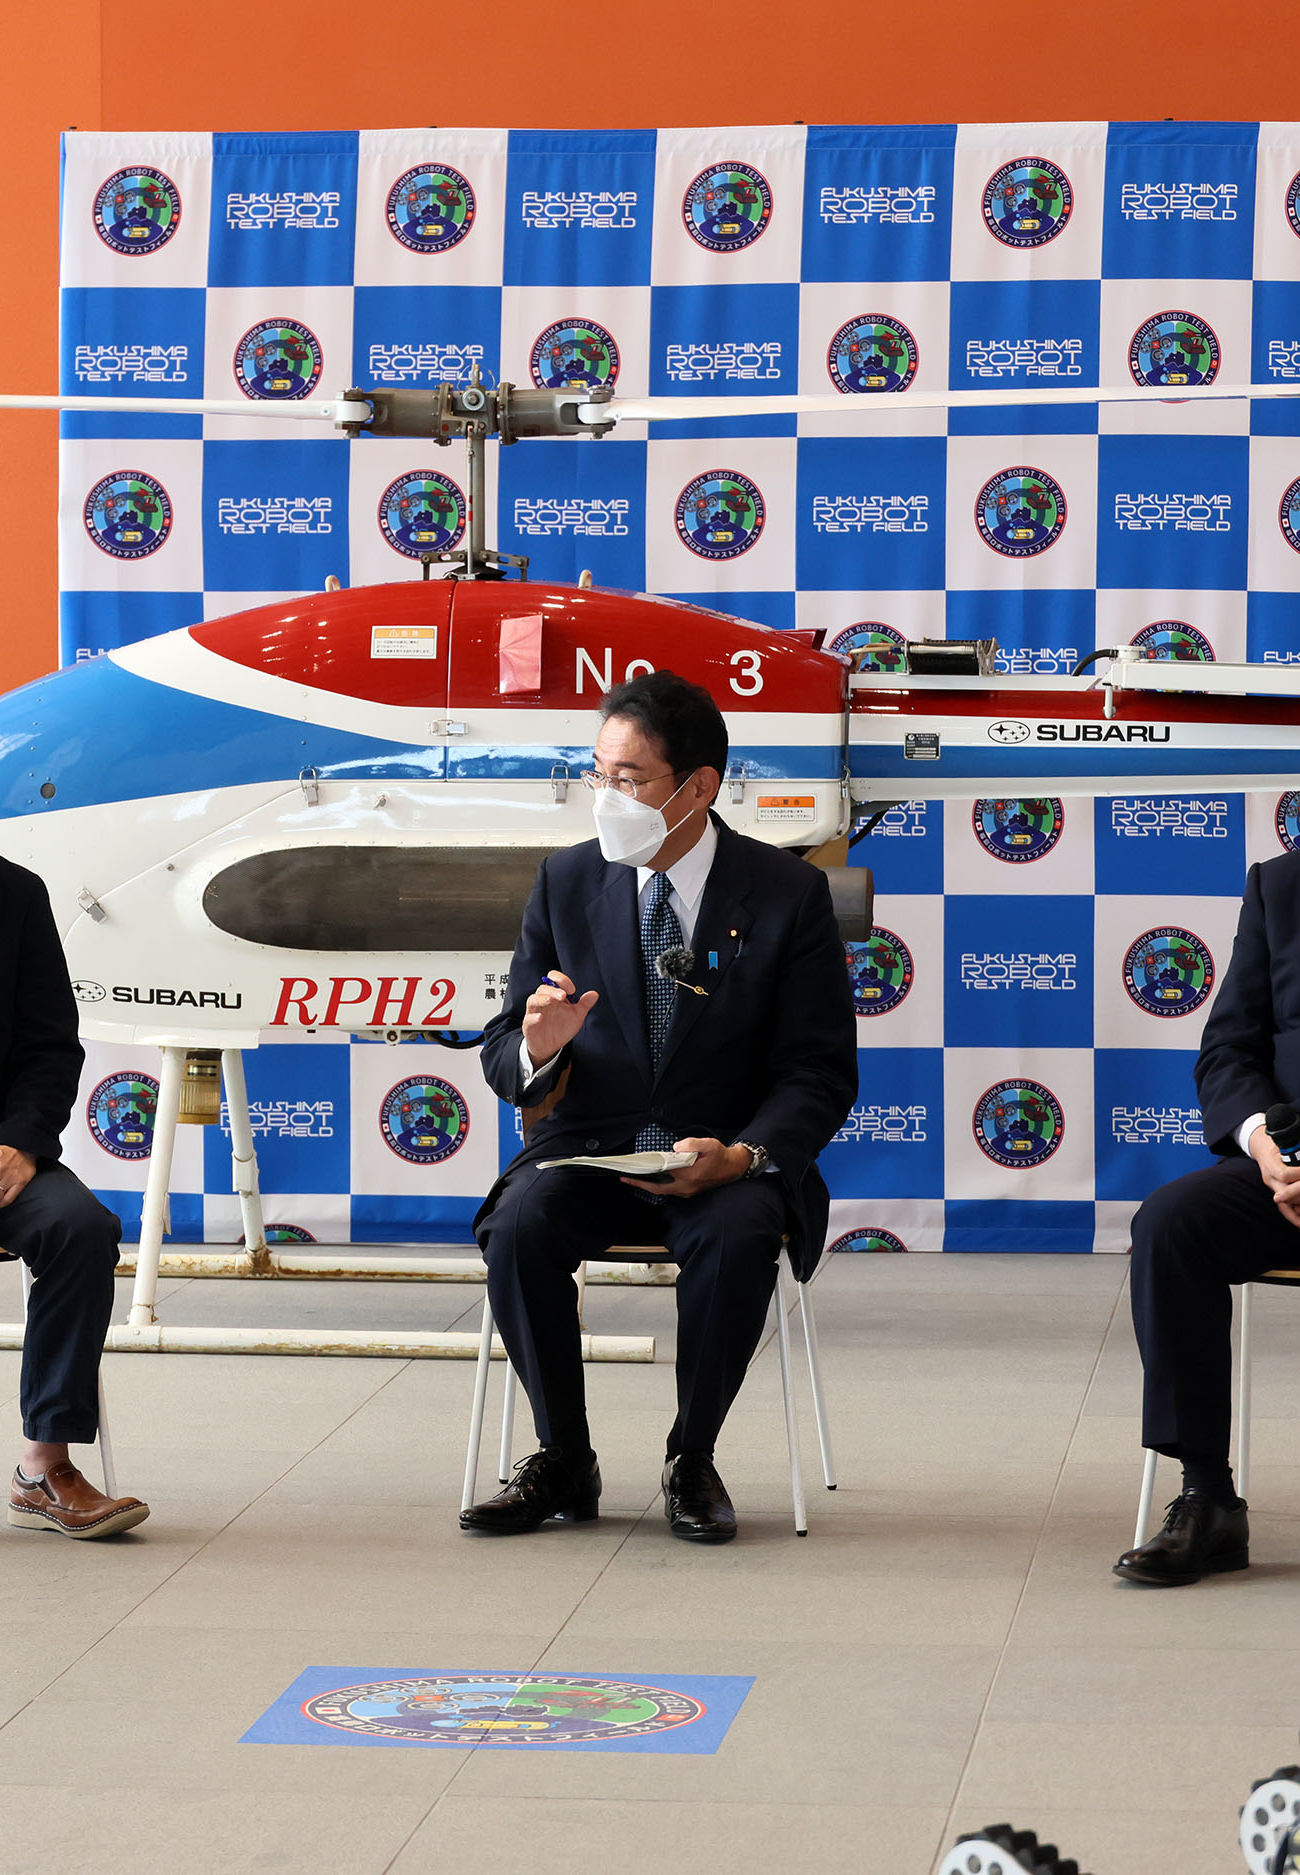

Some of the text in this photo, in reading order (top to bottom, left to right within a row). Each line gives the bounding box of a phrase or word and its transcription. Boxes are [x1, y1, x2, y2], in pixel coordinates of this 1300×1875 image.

[125, 168, 151, 176] ROBOT
[154, 173, 171, 188] TEST
[419, 166, 445, 174] ROBOT
[448, 171, 464, 186] TEST
[745, 169, 761, 184] TEST
[1045, 164, 1062, 179] TEST
[820, 187, 935, 197] FUKUSHIMA
[1121, 184, 1238, 194] FUKUSHIMA
[227, 192, 340, 203] FUKUSHIMA
[522, 192, 637, 202] FUKUSHIMA
[1121, 195, 1238, 209] ROBOT
[227, 203, 340, 218] ROBOT
[522, 203, 637, 217] ROBOT
[820, 198, 935, 212] ROBOT
[820, 213, 935, 223] TEST FIELD
[1121, 210, 1238, 220] TEST FIELD
[227, 218, 340, 229] TEST FIELD
[522, 218, 637, 228] TEST FIELD
[266, 320, 293, 328] ROBOT
[295, 325, 312, 340] TEST
[562, 320, 589, 328] ROBOT
[591, 325, 608, 340] TEST
[860, 316, 887, 324] ROBOT
[889, 321, 907, 336] TEST
[1191, 318, 1208, 333] TEST
[75, 346, 188, 356] FUKUSHIMA
[369, 345, 484, 355] FUKUSHIMA
[667, 343, 781, 354] FUKUSHIMA
[967, 339, 1082, 350] FUKUSHIMA
[75, 356, 188, 370] ROBOT
[369, 356, 484, 370] ROBOT
[667, 354, 781, 369] ROBOT
[967, 350, 1082, 365] ROBOT
[75, 371, 188, 381] TEST FIELD
[369, 371, 421, 381] TEST
[667, 369, 781, 380] TEST FIELD
[967, 365, 1082, 376] TEST FIELD
[116, 473, 142, 481] ROBOT
[144, 478, 161, 493] TEST
[707, 472, 734, 480] ROBOT
[736, 477, 754, 492] TEST
[1038, 474, 1055, 489] TEST
[218, 498, 332, 508] FUKUSHIMA
[515, 499, 629, 509] FUKUSHIMA
[813, 496, 928, 506] FUKUSHIMA
[1115, 494, 1231, 505] FUKUSHIMA
[218, 509, 332, 523] ROBOT
[515, 510, 629, 524] ROBOT
[813, 507, 928, 521] ROBOT
[1115, 505, 1231, 520] ROBOT
[218, 524, 332, 534] TEST FIELD
[515, 525, 629, 535] TEST FIELD
[813, 522, 928, 532] TEST FIELD
[1115, 520, 1231, 531] TEST FIELD
[729, 650, 764, 697] 3
[1036, 724, 1171, 743] SUBARU
[1112, 800, 1227, 811] FUKUSHIMA
[1112, 811, 1227, 826] ROBOT
[871, 826, 927, 837] FIELD
[1112, 826, 1227, 837] TEST FIELD
[1155, 929, 1183, 937] ROBOT
[1185, 934, 1202, 949] TEST
[961, 954, 1076, 964] FUKUSHIMA
[961, 964, 1076, 978] ROBOT
[961, 979, 1076, 989] TEST FIELD
[112, 986, 242, 1010] SUBARU
[269, 977, 456, 1026] RPH2
[412, 1077, 439, 1085] ROBOT
[441, 1082, 458, 1097] TEST
[1005, 1081, 1033, 1089] ROBOT
[1035, 1086, 1052, 1101] TEST
[279, 1127, 333, 1137] FIELD
[872, 1131, 927, 1142] FIELD
[1112, 1132, 1165, 1143] TEST
[467, 1676, 582, 1685] ROBOT
[593, 1682, 658, 1698] TEST
